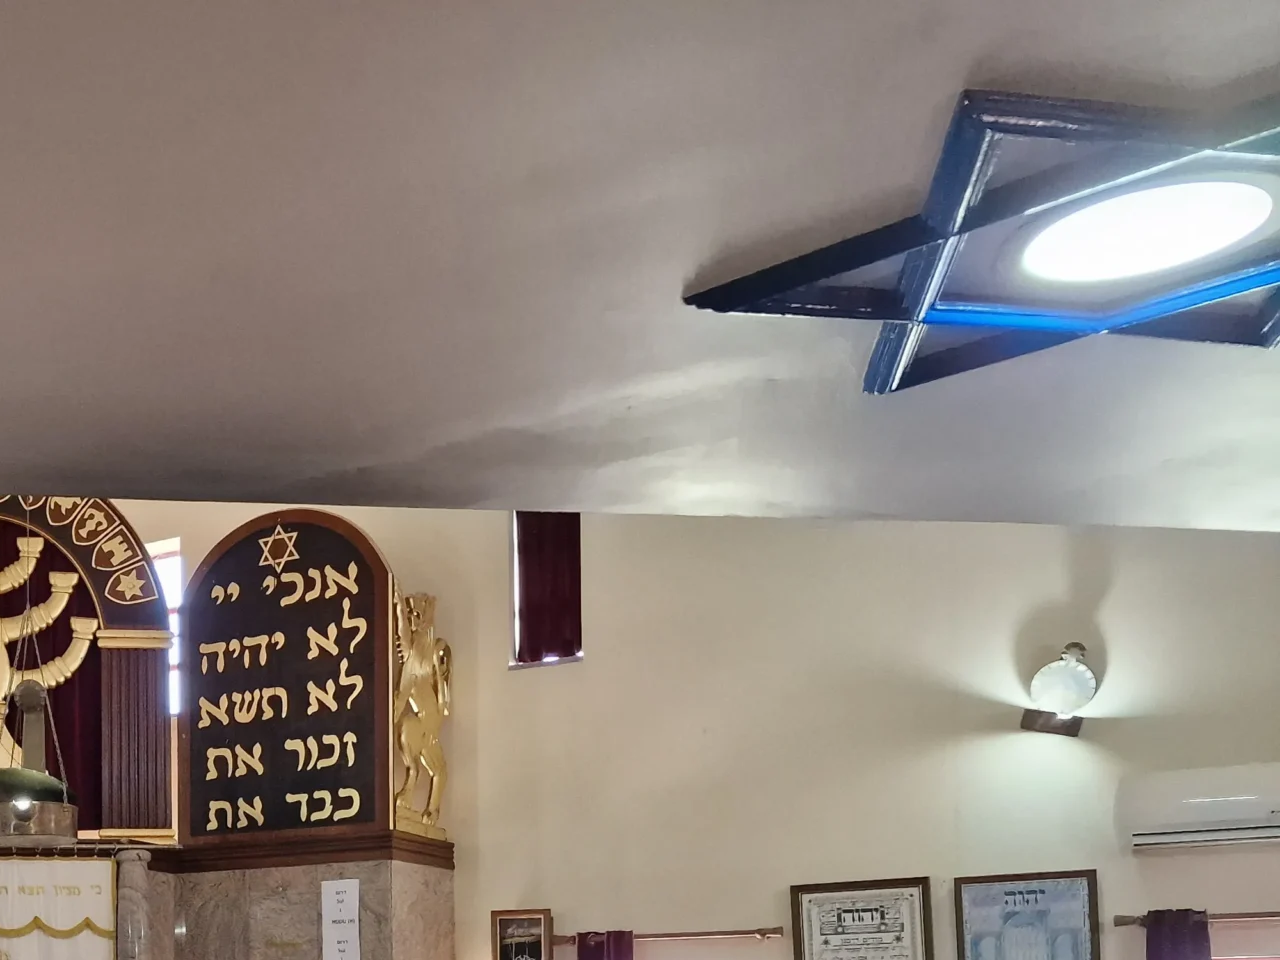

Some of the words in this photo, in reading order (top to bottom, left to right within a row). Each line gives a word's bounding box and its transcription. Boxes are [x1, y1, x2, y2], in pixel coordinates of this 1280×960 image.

[210, 581, 240, 605] יי
[262, 560, 359, 607] אנכי
[306, 597, 367, 661] לא
[199, 631, 285, 675] יהיה
[198, 686, 288, 728] תשא
[306, 657, 363, 716] לא
[206, 742, 264, 780] את
[284, 731, 357, 772] זכור
[206, 795, 265, 831] את
[285, 787, 360, 822] כבד
